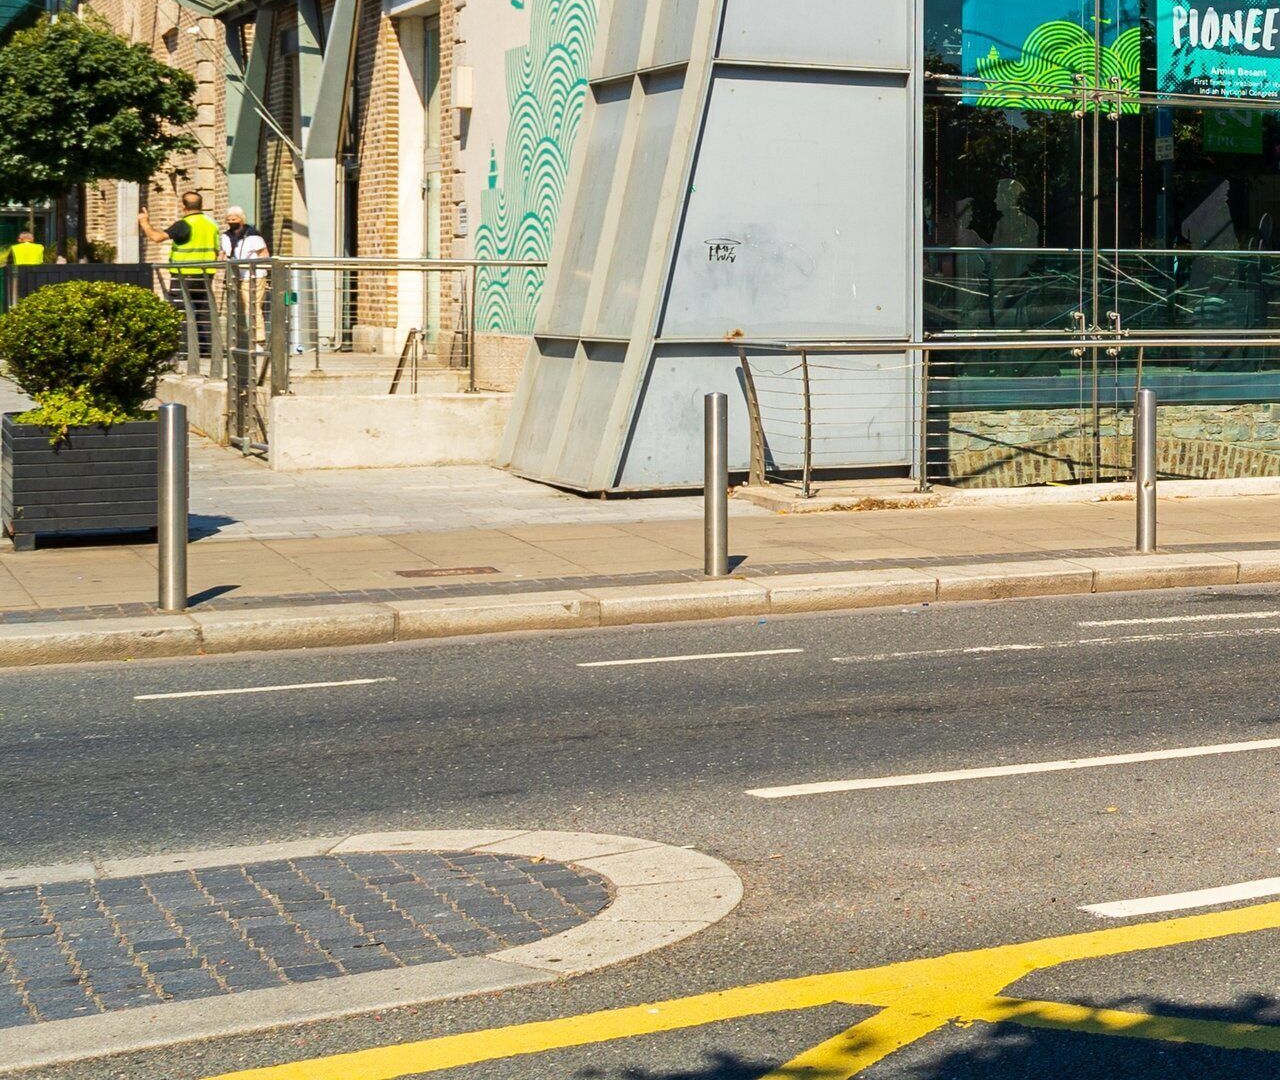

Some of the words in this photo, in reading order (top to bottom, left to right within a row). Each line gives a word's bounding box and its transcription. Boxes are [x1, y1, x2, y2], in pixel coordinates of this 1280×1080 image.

[1211, 67, 1236, 75] Annie
[1237, 67, 1267, 77] Besant
[1249, 89, 1278, 98] Congress
